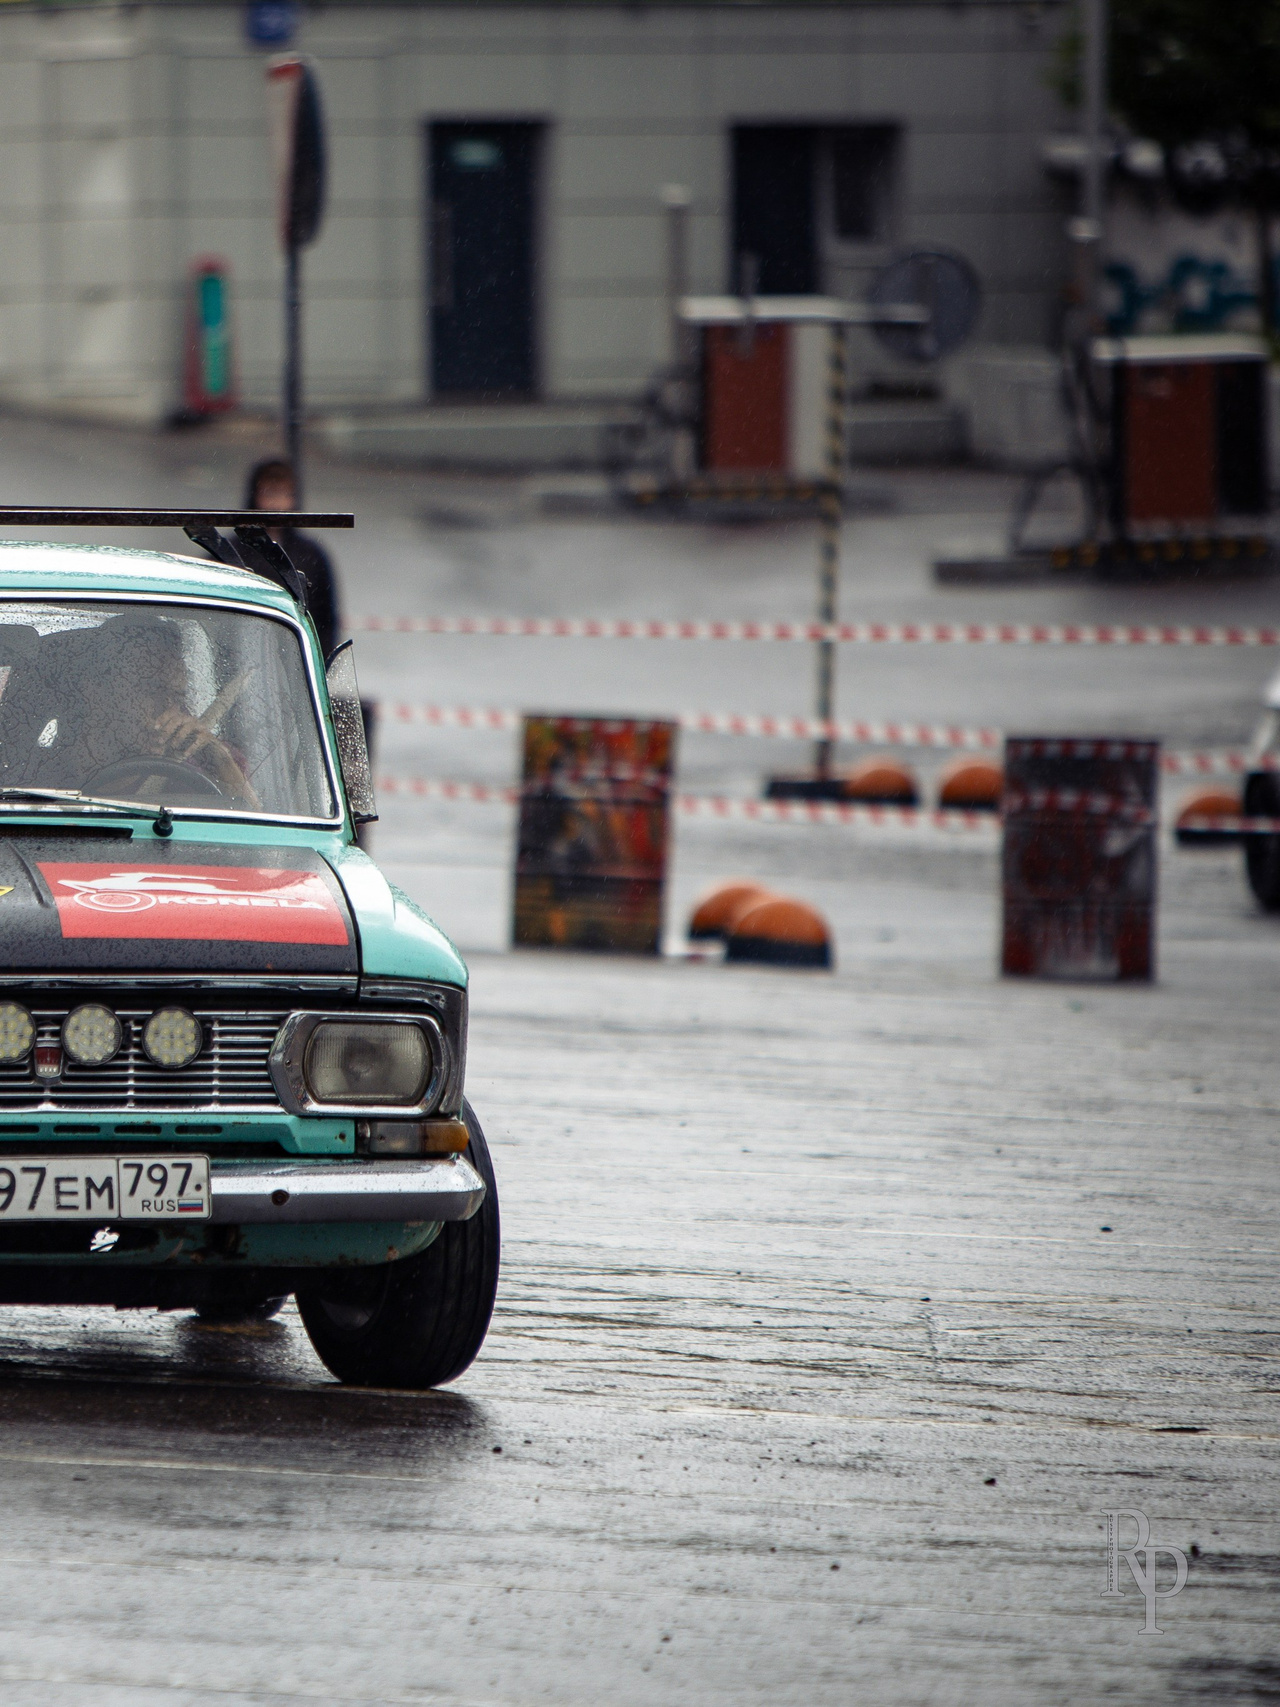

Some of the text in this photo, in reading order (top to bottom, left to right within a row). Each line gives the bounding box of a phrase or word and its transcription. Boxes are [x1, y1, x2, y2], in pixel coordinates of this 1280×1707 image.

[157, 895, 327, 910] KONELA
[122, 1162, 193, 1198] 797
[141, 1199, 176, 1213] RUS
